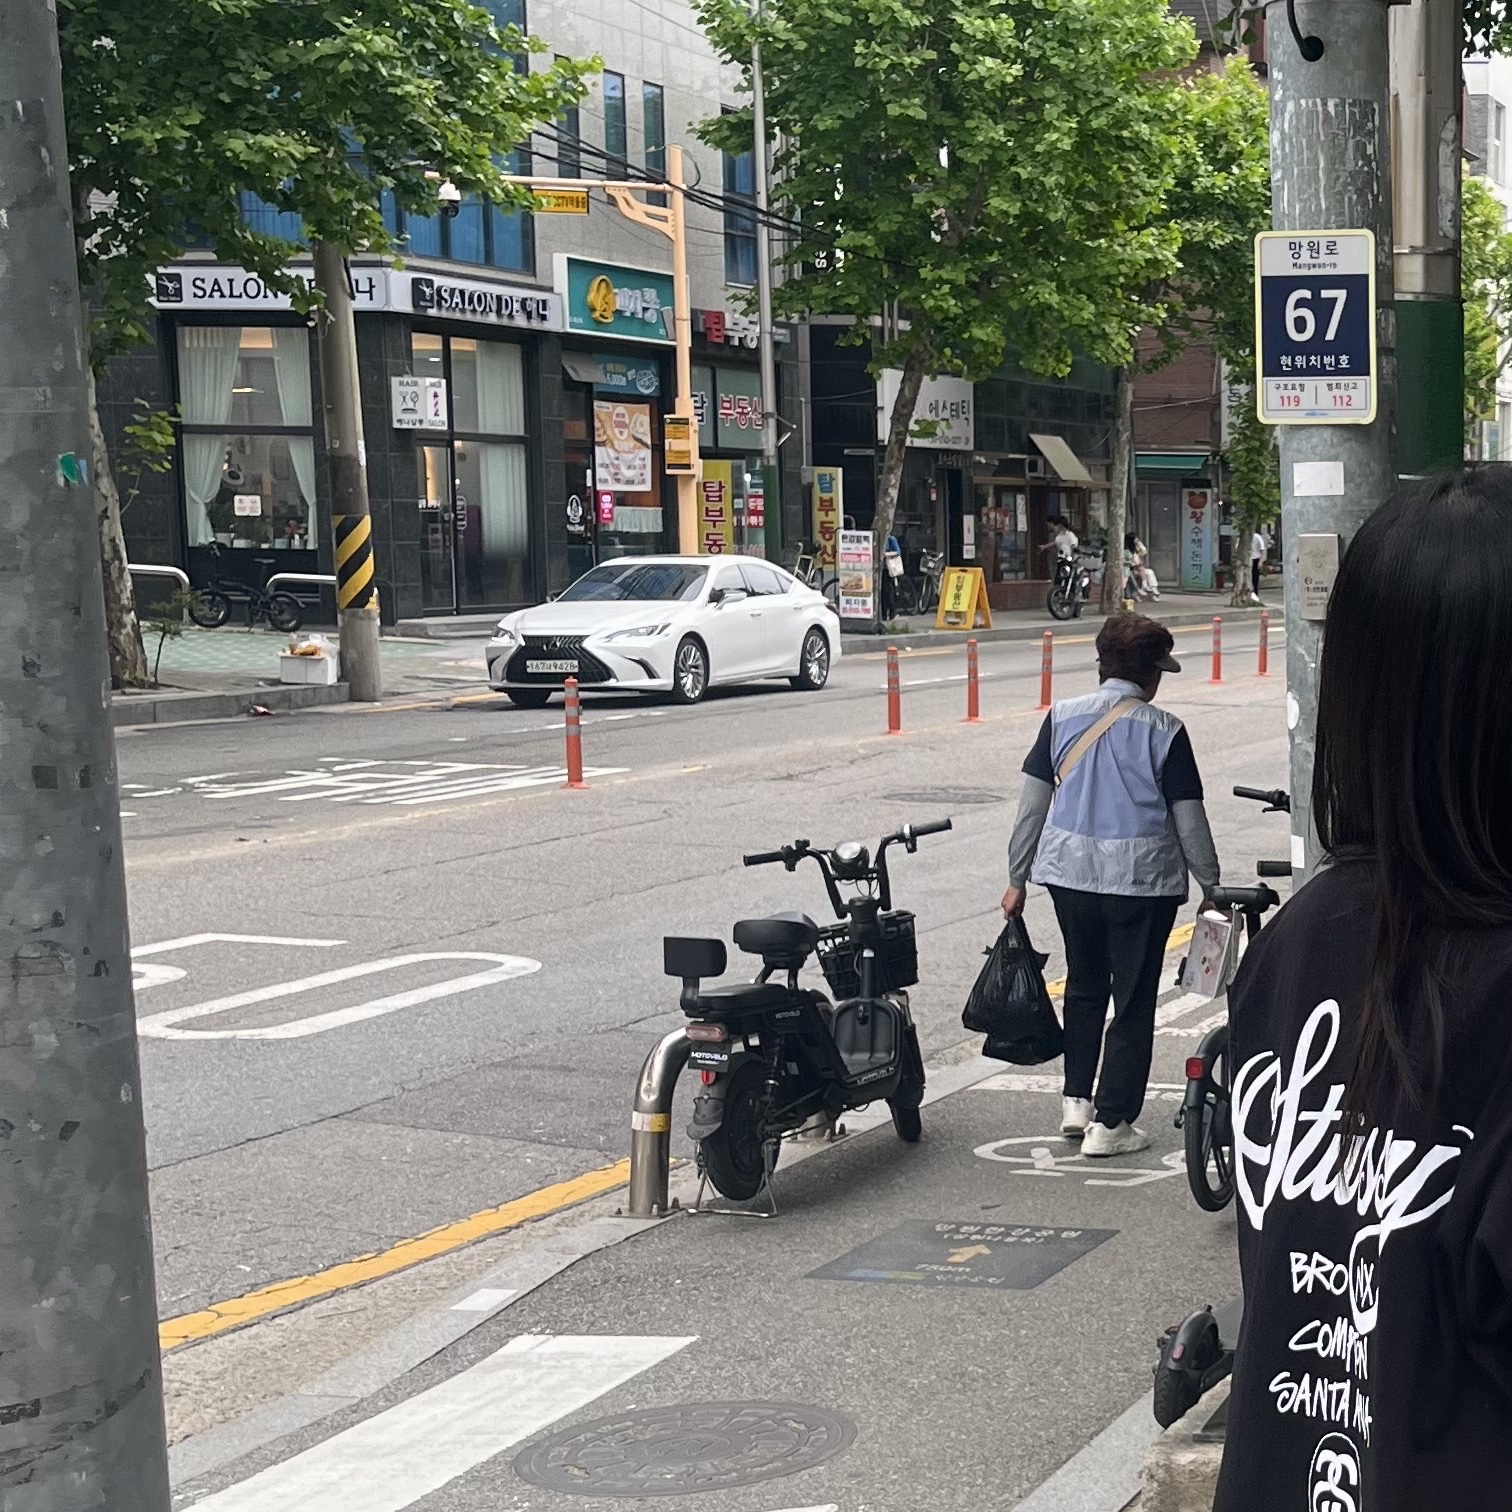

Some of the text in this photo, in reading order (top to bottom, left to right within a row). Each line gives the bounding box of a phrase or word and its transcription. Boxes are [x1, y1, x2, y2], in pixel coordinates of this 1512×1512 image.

[1288, 240, 1339, 260] 망원로
[440, 285, 497, 313] SALON
[501, 295, 522, 315] DE
[1284, 288, 1348, 342] 67
[1279, 354, 1351, 371] 현위치번호
[718, 393, 763, 429] 부동산
[1279, 395, 1300, 407] 119
[1332, 395, 1352, 407] 112
[702, 480, 727, 555] 탑부동
[816, 472, 838, 567] 탑부동산
[1289, 1250, 1376, 1308] BRONX
[1268, 1371, 1350, 1428] SANTA
